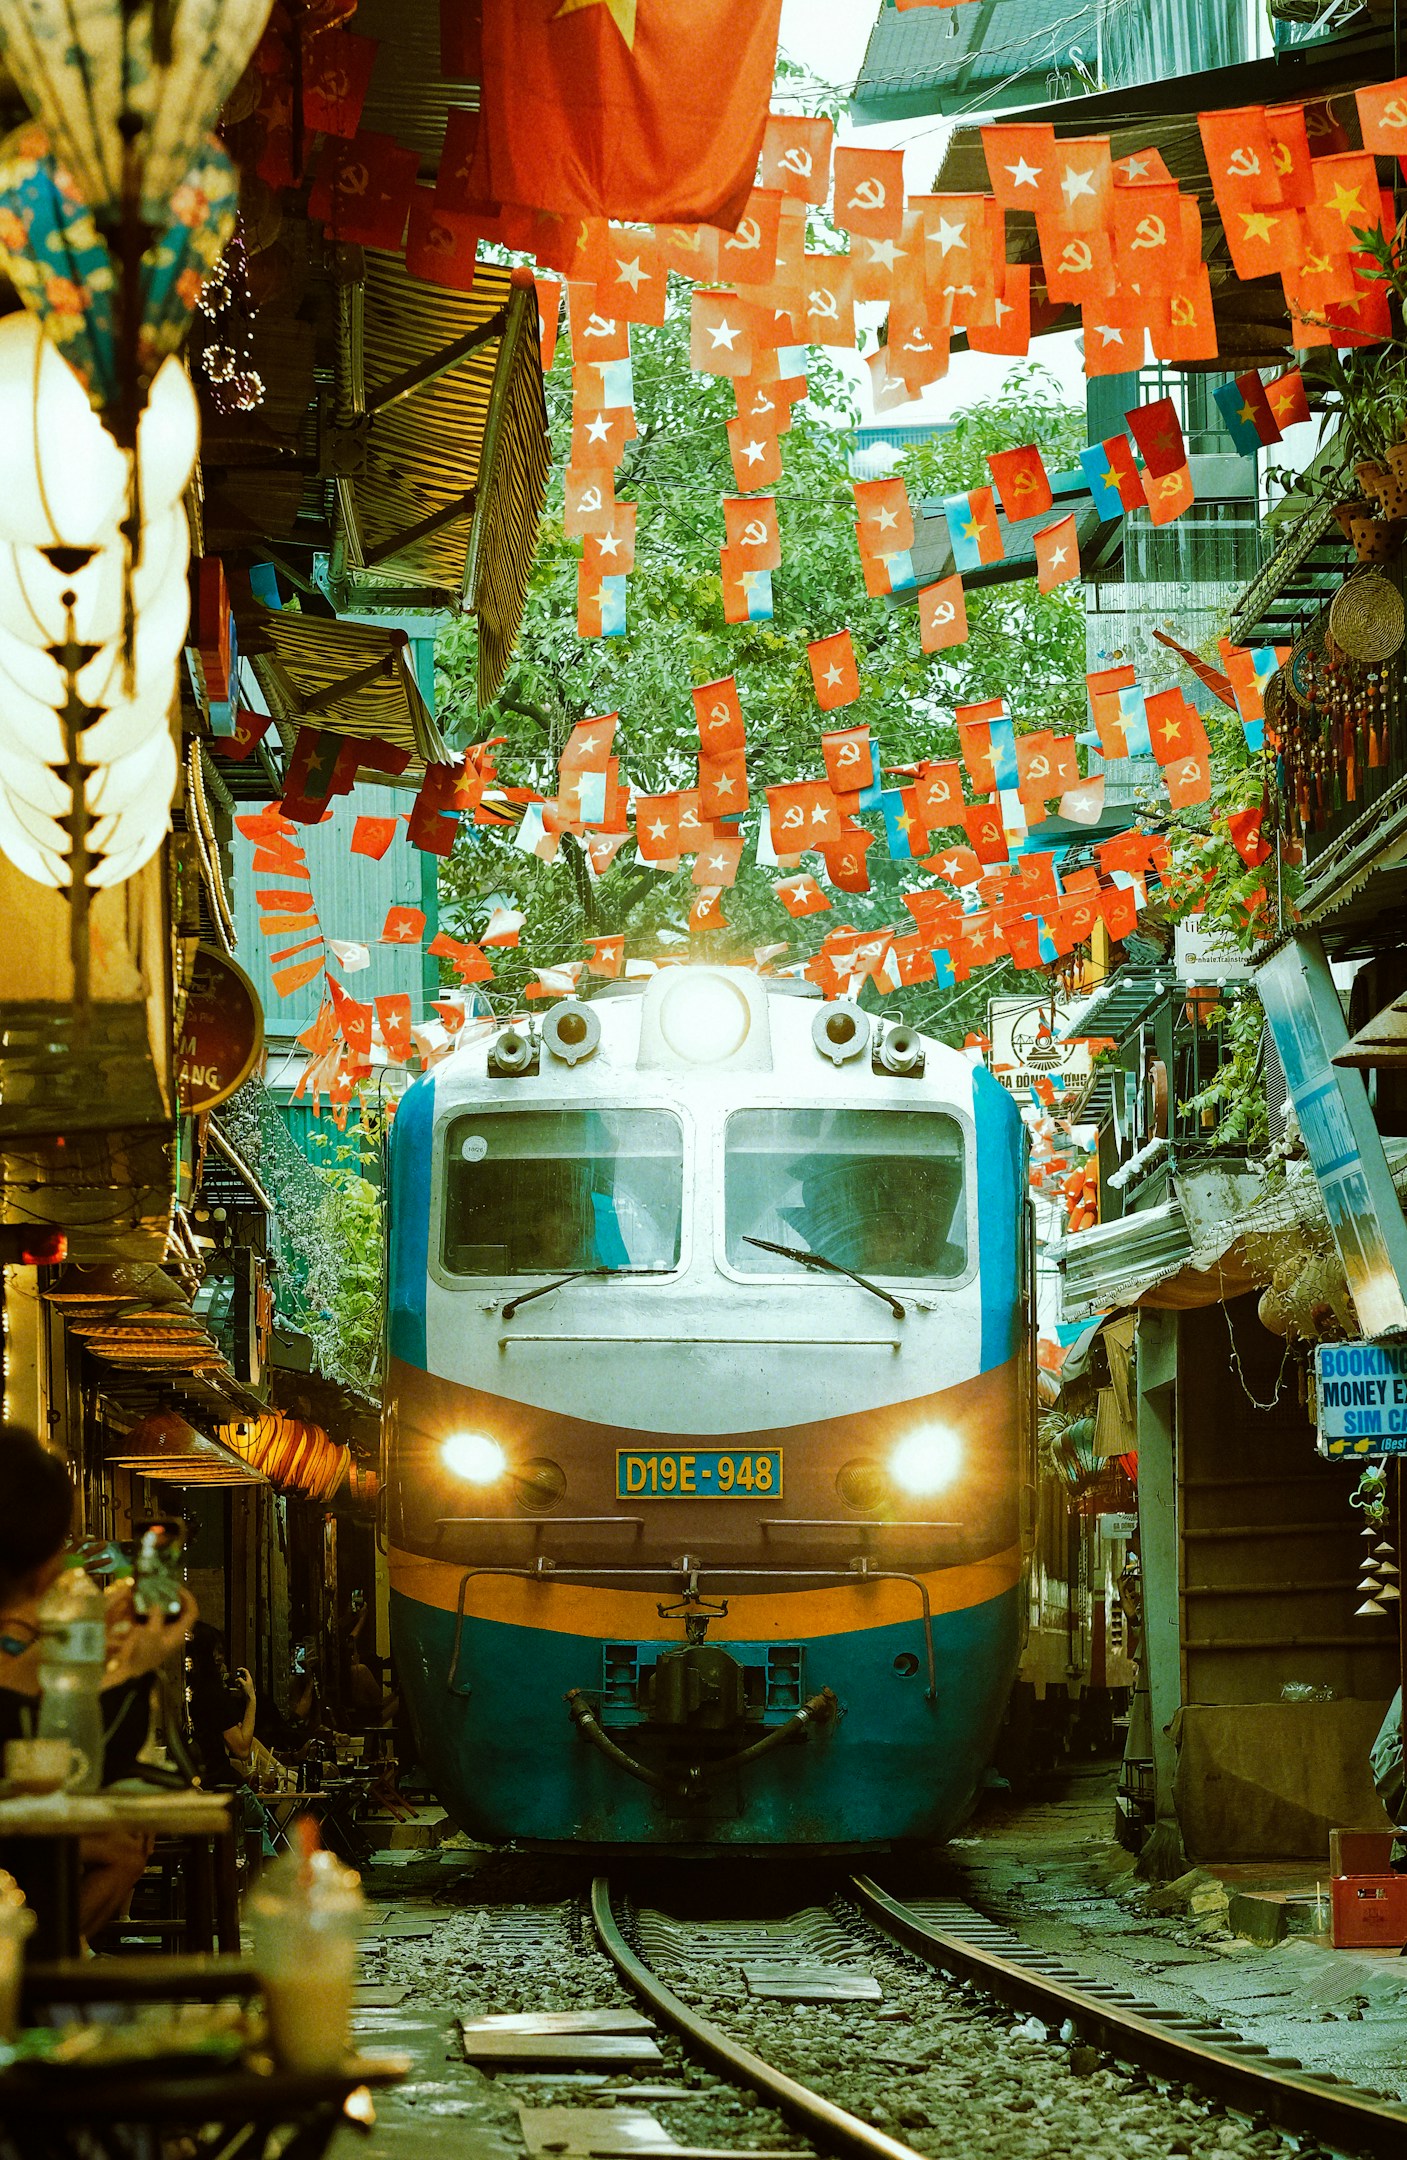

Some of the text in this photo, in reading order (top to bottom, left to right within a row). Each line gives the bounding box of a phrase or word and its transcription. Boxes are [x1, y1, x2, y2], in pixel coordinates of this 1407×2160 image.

[179, 1035, 197, 1056] M
[178, 1059, 221, 1091] ÀNG
[998, 1075, 1012, 1088] GA
[1323, 1379, 1407, 1407] MONEY E
[1344, 1410, 1382, 1434] SIM
